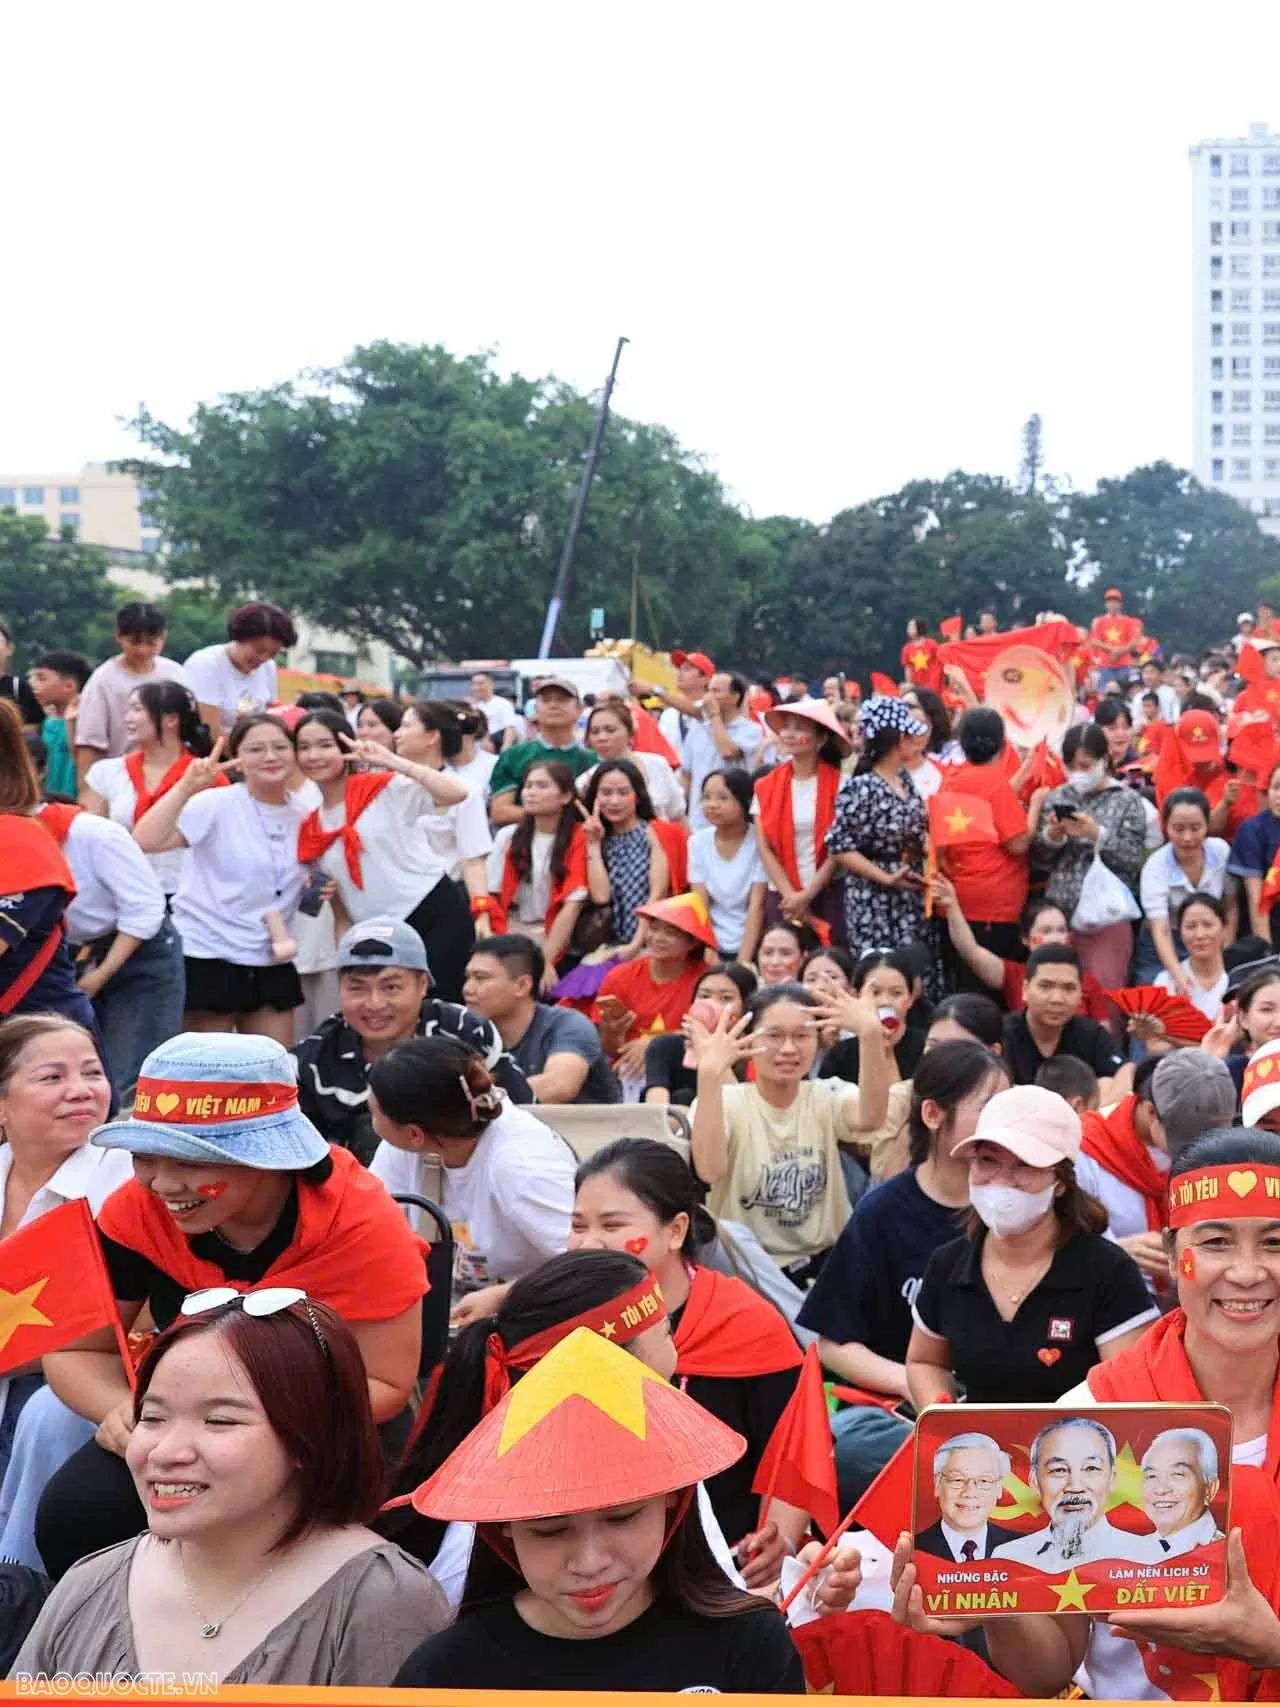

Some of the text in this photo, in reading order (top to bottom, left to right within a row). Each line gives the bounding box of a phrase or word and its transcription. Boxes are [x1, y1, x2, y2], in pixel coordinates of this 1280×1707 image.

[186, 1094, 223, 1119] VIỆT
[225, 1097, 261, 1115] NAM
[1179, 1180, 1193, 1206] TÔI
[1194, 1176, 1219, 1201] YÊU
[620, 1304, 642, 1329] TÔI
[983, 1570, 1009, 1586] BẬC
[1109, 1563, 1210, 1580] LÀM NÊN LỊCH SỬ
[926, 1587, 1018, 1611] VĨ NHÂN
[1115, 1578, 1210, 1606] ĐẤT VIỆT
